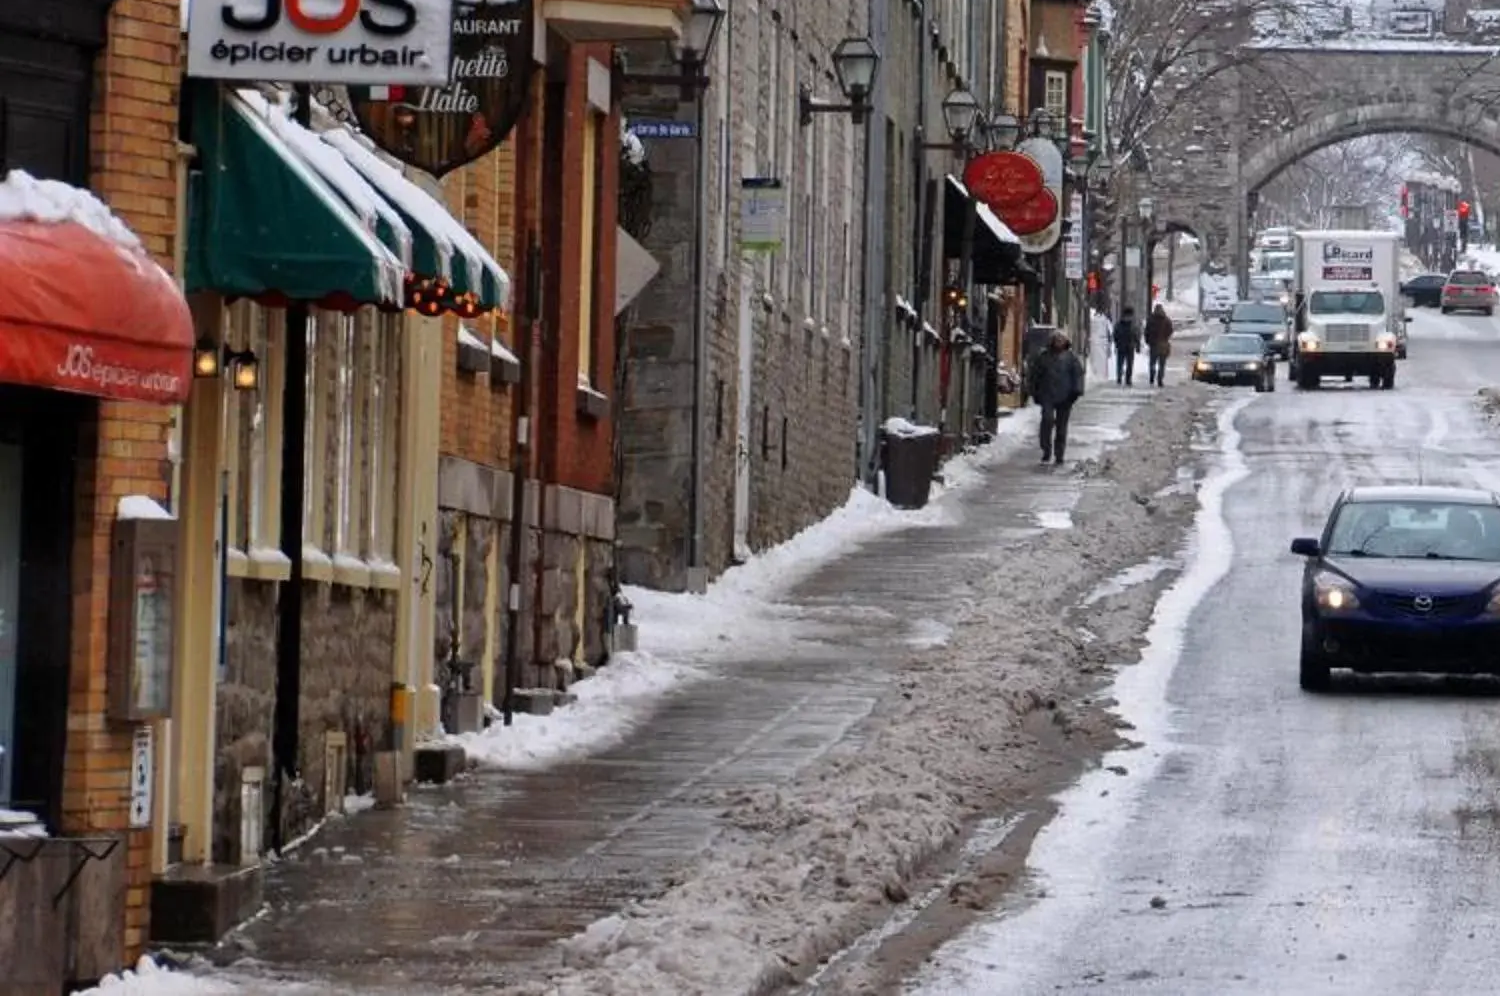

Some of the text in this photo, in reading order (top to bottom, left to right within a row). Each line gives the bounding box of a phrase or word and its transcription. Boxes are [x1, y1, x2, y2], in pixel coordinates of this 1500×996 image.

[453, 18, 522, 35] AURANT
[210, 40, 317, 66] épicier
[56, 344, 94, 378] JOS
